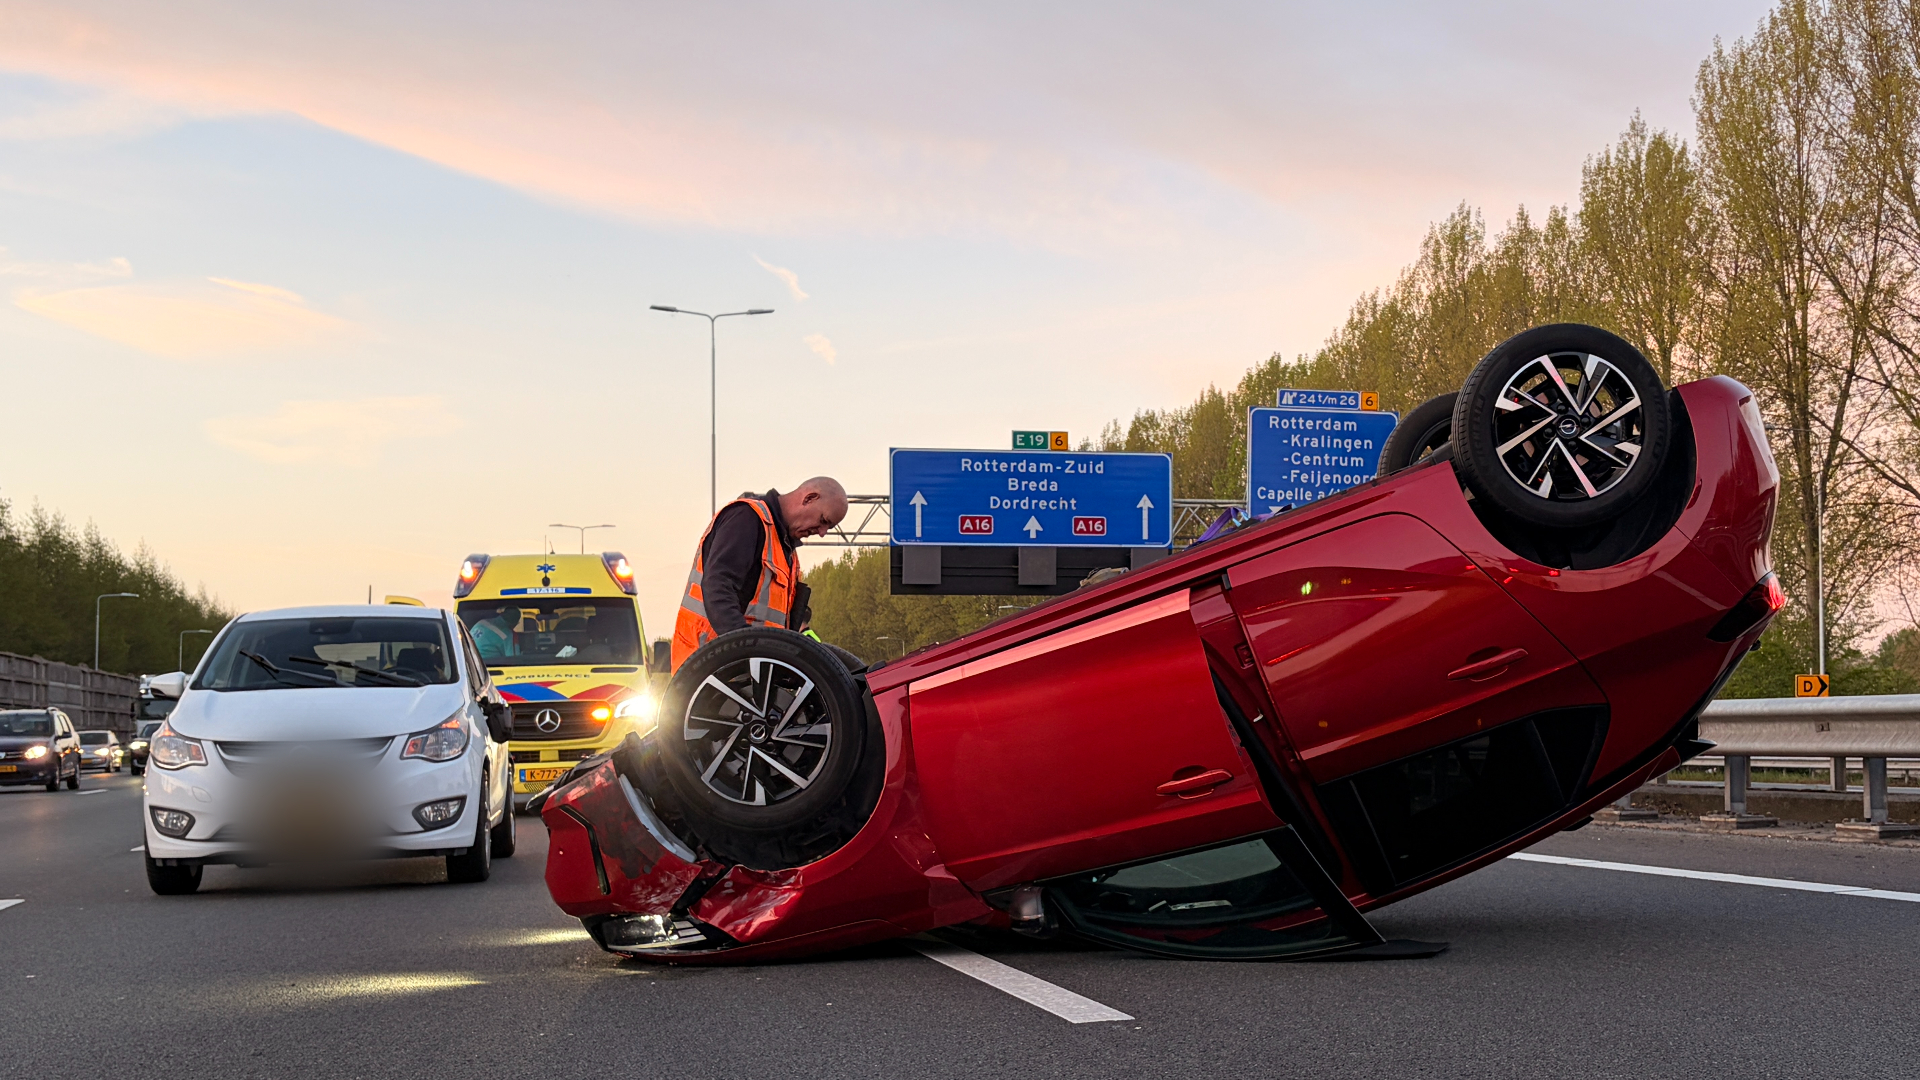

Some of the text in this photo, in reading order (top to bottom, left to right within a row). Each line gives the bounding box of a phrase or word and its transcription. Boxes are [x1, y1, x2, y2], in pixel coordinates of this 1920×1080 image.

[1298, 393, 1356, 406] 24 t/m 26
[1365, 396, 1374, 407] 6
[1269, 415, 1357, 432] Rotterdam
[1016, 434, 1045, 447] E 19
[1054, 436, 1064, 447] 6
[1282, 434, 1373, 453] -Kralingen
[1283, 451, 1364, 467] -Centrum
[961, 458, 1104, 474] Rotterdam-Zuid
[1008, 477, 1058, 492] Breda
[1257, 486, 1341, 502] Capelle a/
[989, 495, 1077, 511] Dordrecht
[962, 518, 990, 531] A16
[1076, 520, 1104, 532] A16
[504, 673, 590, 681] AMBULANCE
[1803, 680, 1813, 693] D
[529, 769, 568, 780] K-772-
